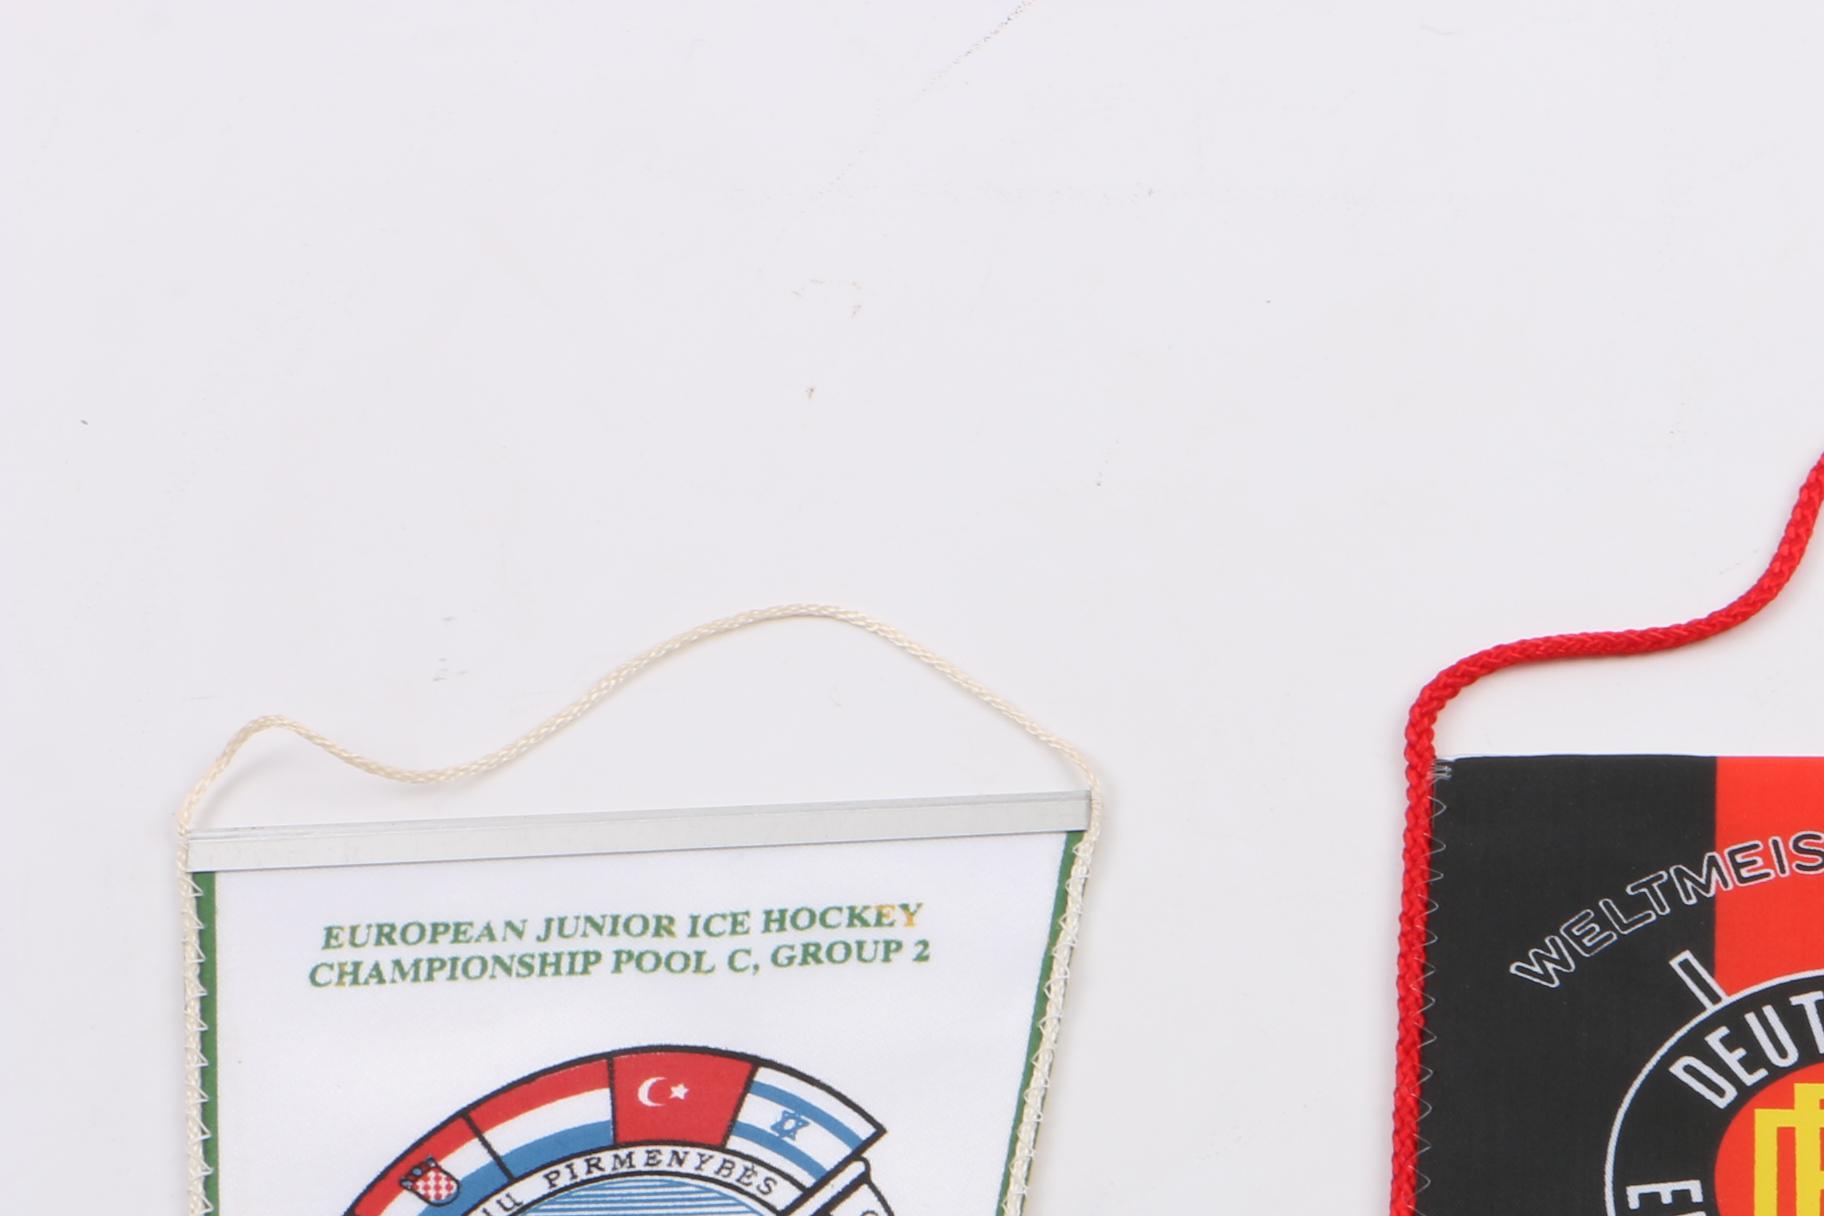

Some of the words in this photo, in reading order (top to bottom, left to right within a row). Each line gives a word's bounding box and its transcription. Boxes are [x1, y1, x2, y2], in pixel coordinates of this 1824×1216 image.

[321, 919, 527, 950] EUROPEAN
[536, 913, 677, 943] JUNIOR
[687, 910, 751, 938] ICE
[761, 902, 923, 934] HOCKEY
[309, 950, 602, 988] CHAMPIONSHIP
[610, 949, 716, 974] POOL
[727, 949, 760, 976] C,
[770, 939, 904, 968] GROUP
[912, 939, 931, 963] 2
